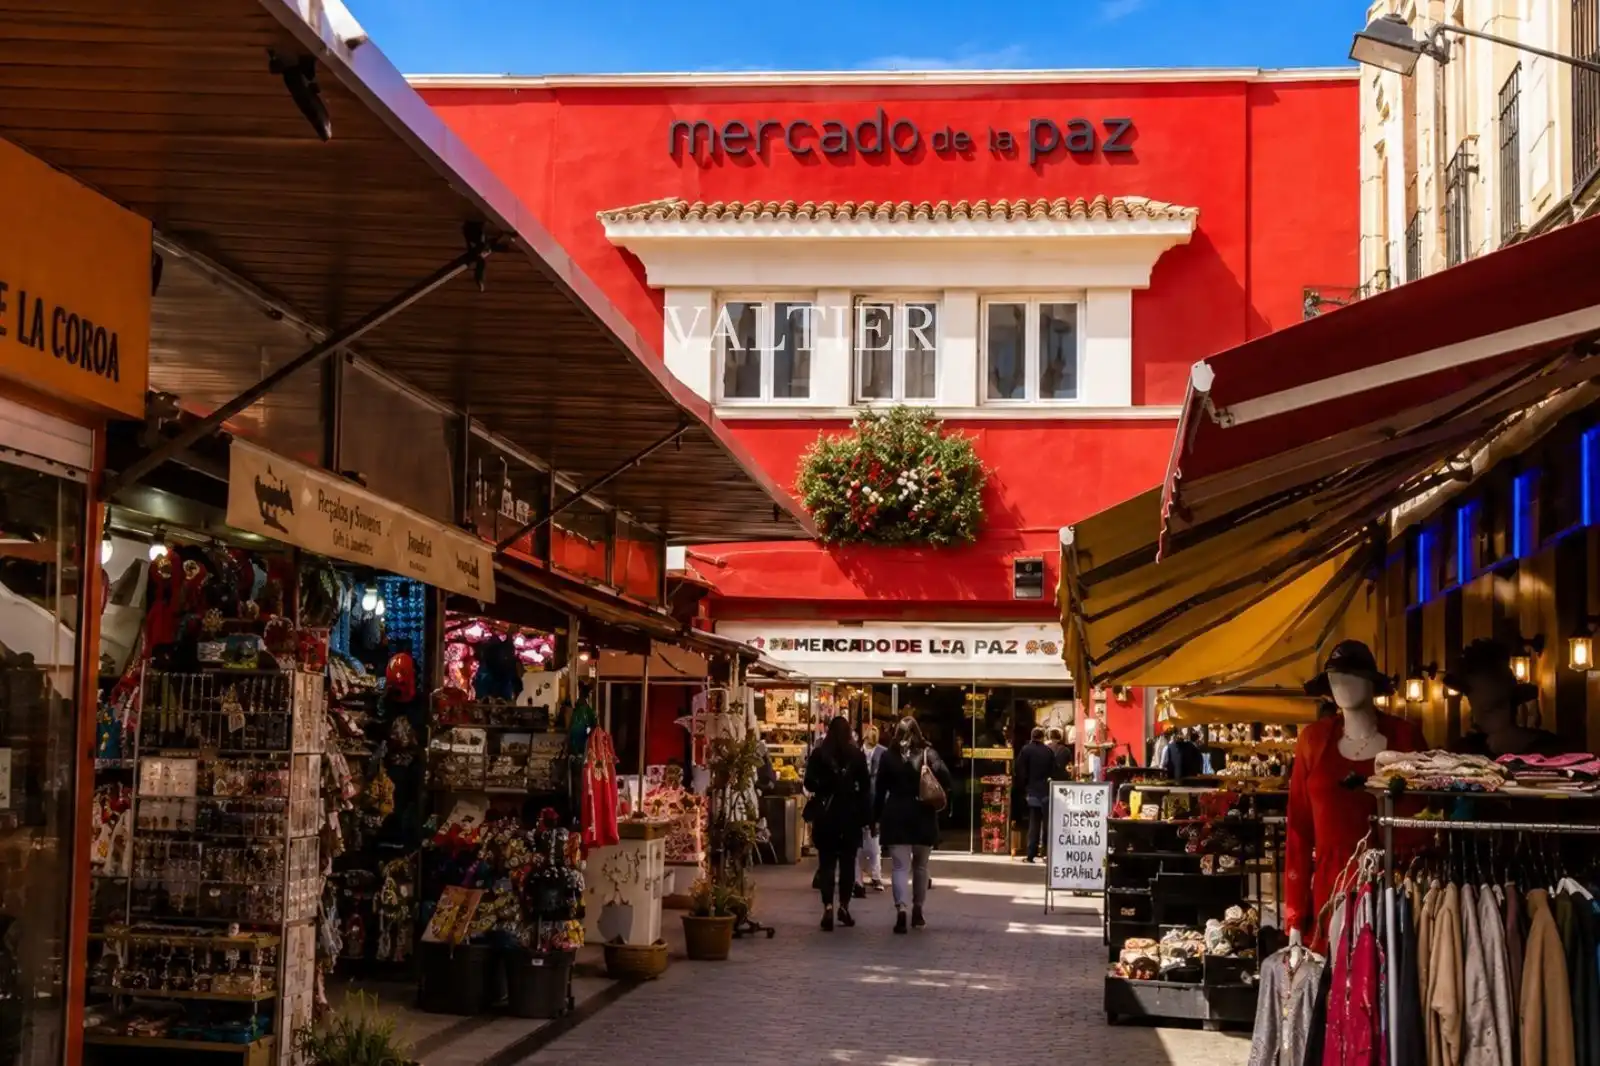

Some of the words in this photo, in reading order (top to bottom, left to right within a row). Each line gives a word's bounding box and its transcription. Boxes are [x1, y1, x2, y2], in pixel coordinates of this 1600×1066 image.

[669, 106, 918, 154] mercado
[931, 126, 971, 151] de
[987, 127, 1013, 151] la
[1028, 117, 1133, 165] paz
[18, 290, 44, 352] LA
[52, 306, 119, 382] COROA
[794, 638, 891, 652] MERCADO
[895, 639, 922, 652] DE
[974, 639, 1018, 654] PAZ
[1066, 850, 1093, 862] MODA
